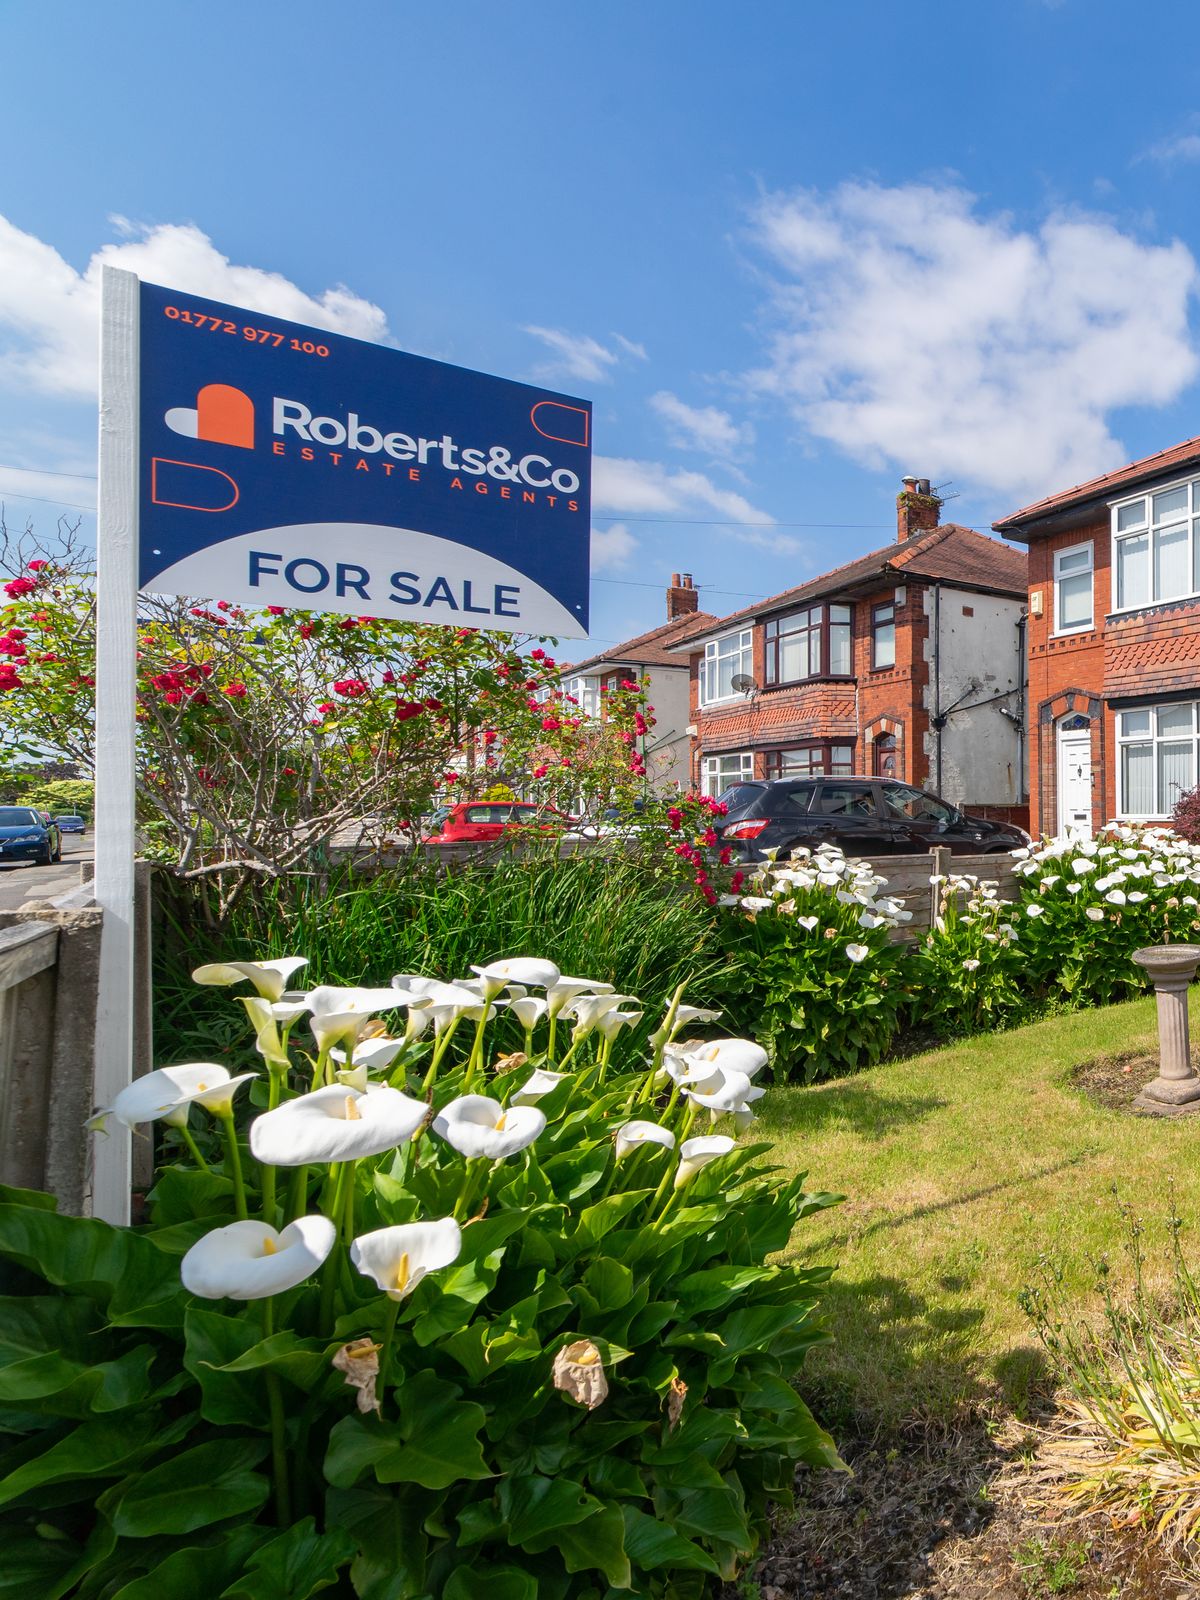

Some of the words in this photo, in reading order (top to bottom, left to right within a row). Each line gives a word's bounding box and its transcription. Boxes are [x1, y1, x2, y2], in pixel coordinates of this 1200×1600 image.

[164, 305, 237, 335] 01772
[242, 326, 286, 348] 977
[290, 338, 331, 358] 100
[272, 396, 580, 495] Roberts&Co
[272, 440, 421, 482] ESTATE
[449, 476, 579, 513] AGENTS
[248, 550, 372, 601] FOR
[388, 571, 522, 618] SALE
